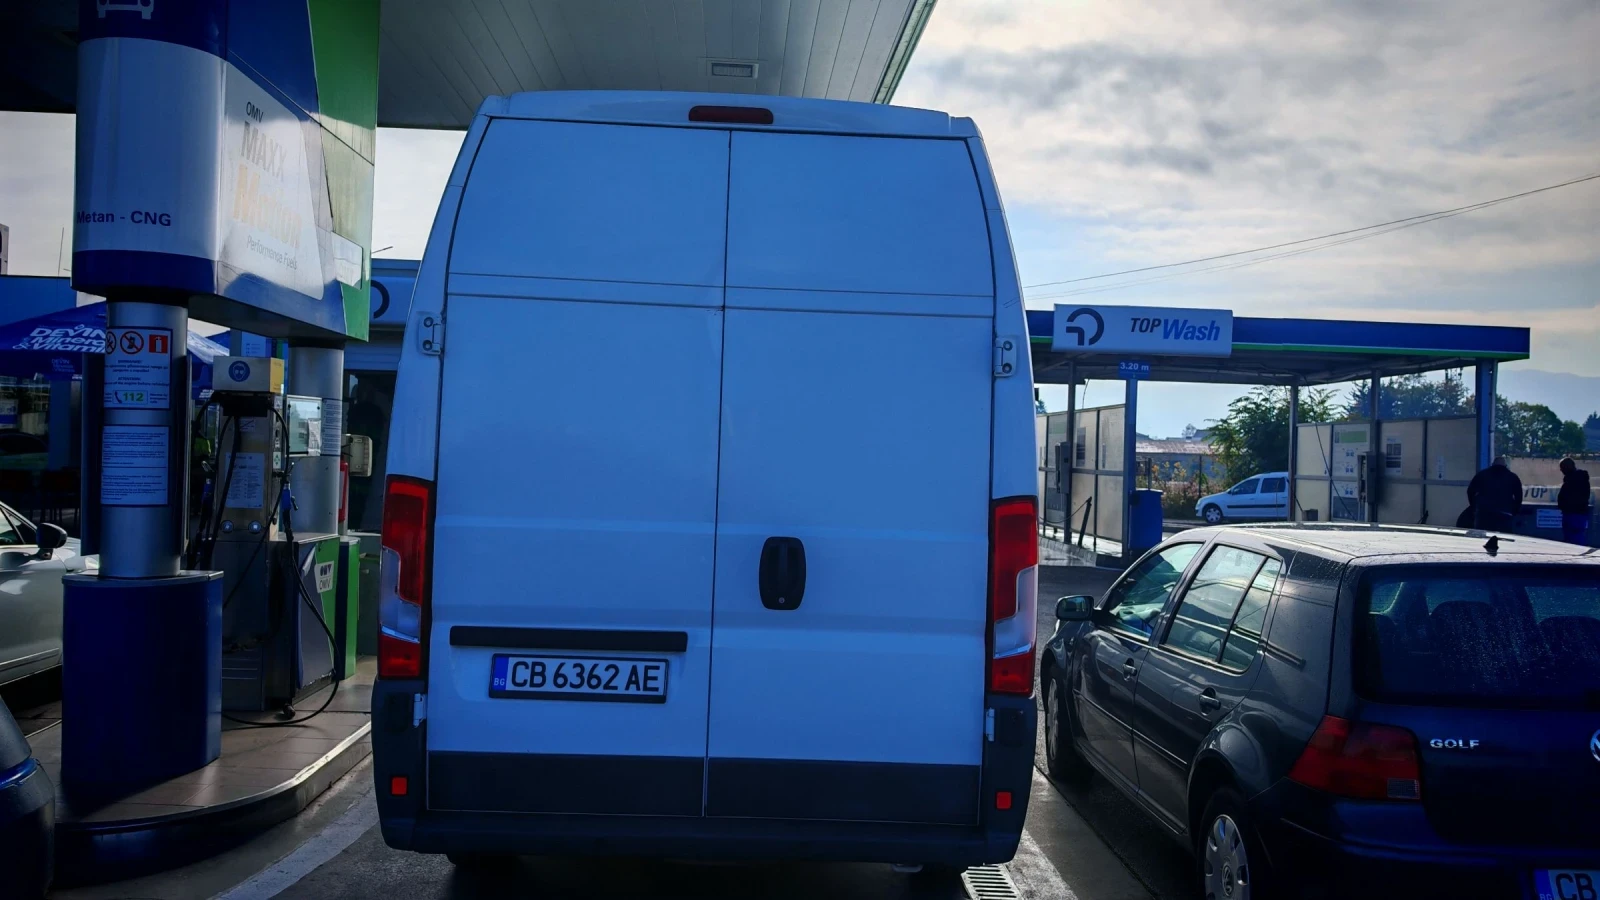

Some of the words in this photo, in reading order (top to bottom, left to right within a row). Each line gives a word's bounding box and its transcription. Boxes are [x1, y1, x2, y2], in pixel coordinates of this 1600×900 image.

[246, 100, 264, 124] OMV
[240, 120, 288, 183] MAXX
[77, 210, 115, 225] Metan
[130, 210, 172, 227] CNG
[247, 235, 284, 265] Performance
[29, 325, 106, 339] DEVIN
[1130, 317, 1162, 333] TOP
[1162, 318, 1221, 341] Wash
[32, 342, 106, 353] Vitami
[40, 336, 106, 346] Minera
[1120, 362, 1139, 371] 3.20
[123, 392, 144, 402] 112
[493, 677, 506, 686] BG
[511, 660, 547, 688] CB
[552, 662, 620, 690] 6362
[624, 664, 661, 692] AE
[1429, 738, 1480, 749] GOLF
[1555, 872, 1598, 900] CB
